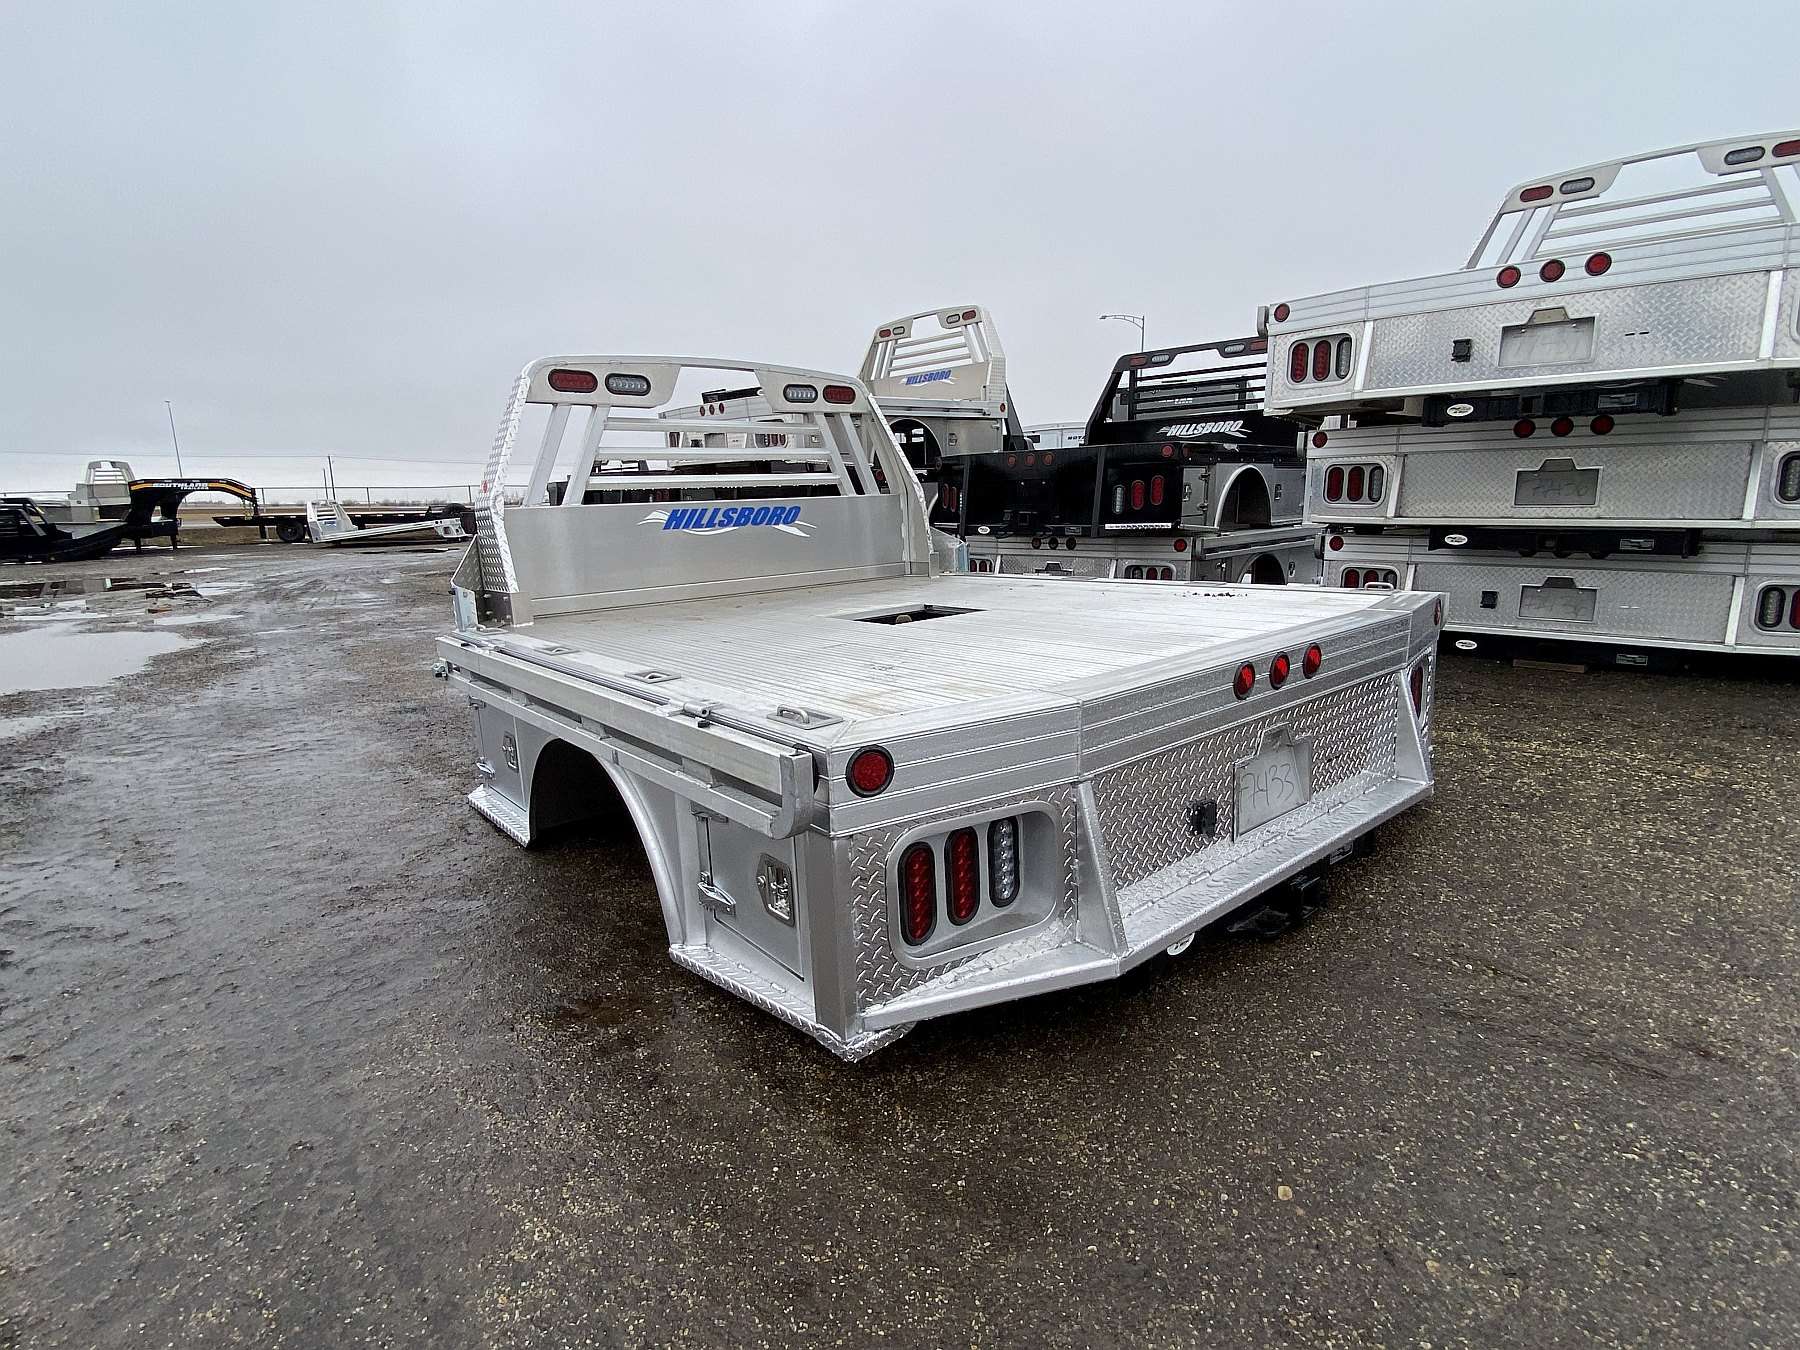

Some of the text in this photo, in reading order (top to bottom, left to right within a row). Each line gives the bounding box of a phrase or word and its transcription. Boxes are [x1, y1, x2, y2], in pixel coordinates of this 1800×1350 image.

[904, 368, 952, 386] HILLSBORO
[1166, 419, 1244, 437] HILLSBORO
[663, 505, 802, 531] HILLSBORO
